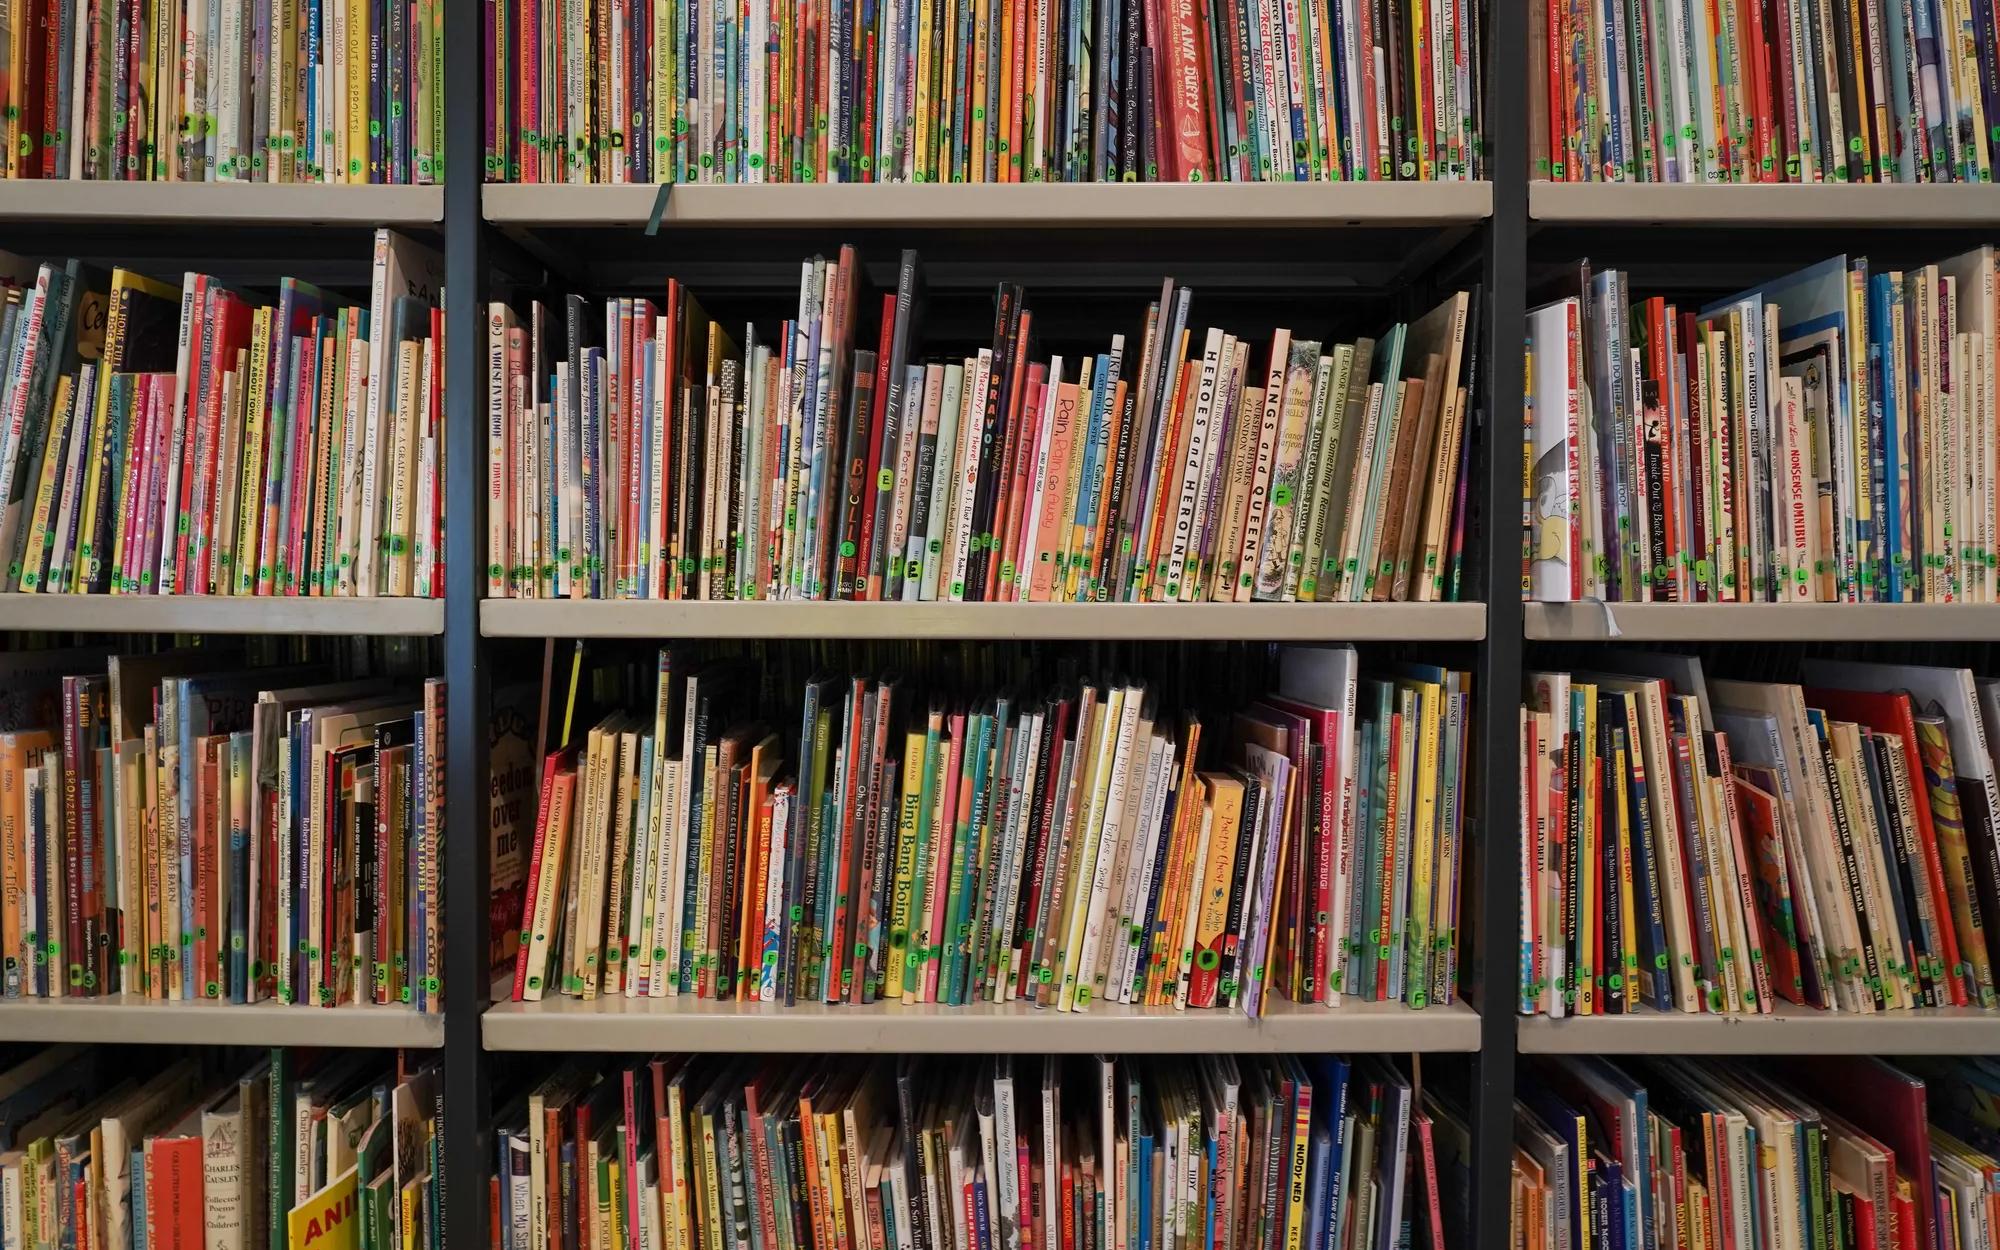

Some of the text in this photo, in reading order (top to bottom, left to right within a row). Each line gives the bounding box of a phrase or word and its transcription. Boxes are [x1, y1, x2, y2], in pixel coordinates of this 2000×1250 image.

[1253, 48, 1263, 76] Horses
[1262, 16, 1274, 85] Red Red Red
[1274, 24, 1285, 61] Kittens
[1182, 24, 1198, 111] ANN DUFFY
[1256, 86, 1267, 132] Dreamland
[30, 296, 45, 331] WALKING
[22, 349, 36, 379] WINTER
[250, 368, 258, 395] ABOUT
[401, 348, 410, 389] WILLIAM
[492, 351, 502, 381] MOUSE
[1338, 350, 1350, 390] ELEANOR
[12, 382, 30, 436] WONDERLAND
[248, 398, 256, 424] TOWN
[400, 392, 408, 423] BLAKE
[634, 378, 642, 406] WHAT
[1332, 392, 1344, 430] FARJEON
[1749, 375, 1758, 407] TOUCH
[492, 416, 502, 439] ROOF
[633, 409, 641, 430] CAN
[857, 400, 866, 434] ELLIOTT
[970, 371, 988, 461] Macavity's not there!
[983, 374, 999, 459] BRAVO!
[1090, 348, 1122, 514] LIKE IT OR NOT Gavin Ewart
[1239, 408, 1251, 450] LONDON
[1690, 378, 1701, 446] ANZAC TED
[1750, 410, 1758, 427] Your
[1858, 361, 1869, 500] HIS SHOES WERE FAR TOO TIGHT
[398, 446, 406, 476] GRAIN
[652, 400, 664, 515] WHEN SADNESS COMES TO CALL
[921, 445, 932, 462] The
[1244, 400, 1260, 486] NURSERY RHYMES
[1322, 436, 1339, 486] Something
[1751, 430, 1759, 458] HAIR?
[493, 462, 501, 500] EDWARDS
[790, 436, 801, 506] ON THE FARM
[1050, 475, 1061, 491] Go
[1105, 398, 1132, 549] DON'T CALL ME PRINCESS! Kate Evans
[1171, 350, 1217, 579] HEROES and HEROINES
[1235, 455, 1246, 483] TOWN
[1244, 369, 1282, 563] KINGS and QUEENS
[397, 479, 405, 491] OF
[1790, 449, 1806, 549] NONSENSE OMNIBUS
[396, 495, 404, 520] SAND
[915, 494, 928, 524] Letters
[1043, 494, 1061, 528] Away
[1313, 498, 1330, 548] Remember
[1650, 453, 1664, 565] Inside Out Back Again
[590, 753, 598, 766] Wry
[588, 768, 596, 793] Rhymes
[1387, 771, 1397, 813] MESSING
[1720, 750, 1737, 820] Come Back Hercules
[66, 770, 77, 853] BRONZEVILLE
[493, 802, 520, 829] over
[533, 778, 552, 866] CATS SLEEP ANYWHERE
[856, 785, 866, 820] Oh, No!
[1224, 799, 1233, 811] The
[584, 808, 594, 848] Troublesome
[1217, 816, 1234, 852] Poetry
[1385, 817, 1394, 858] AROUND
[301, 817, 310, 889] Robert Browning
[583, 851, 591, 870] Times
[873, 806, 890, 892] Relatively Speaking
[893, 793, 919, 927] Bing Bang Boing
[1320, 841, 1330, 890] LADYBUG!
[1339, 853, 1349, 875] Poem
[1382, 871, 1392, 912] MONKEY
[1568, 884, 1576, 941] CHRISTMAS
[299, 1110, 309, 1176] Charles Causley
[204, 1163, 240, 1173] CHARLES
[205, 1174, 239, 1184] CAUSLEY
[1216, 1131, 1227, 1222] Leave Me Alone
[1267, 1136, 1280, 1219] DAYDREAMERS
[1293, 1144, 1305, 1202] NUDDY NED
[800, 1182, 808, 1201] Night
[206, 1221, 239, 1230] Children
[1677, 1203, 1686, 1248] MONKEY
